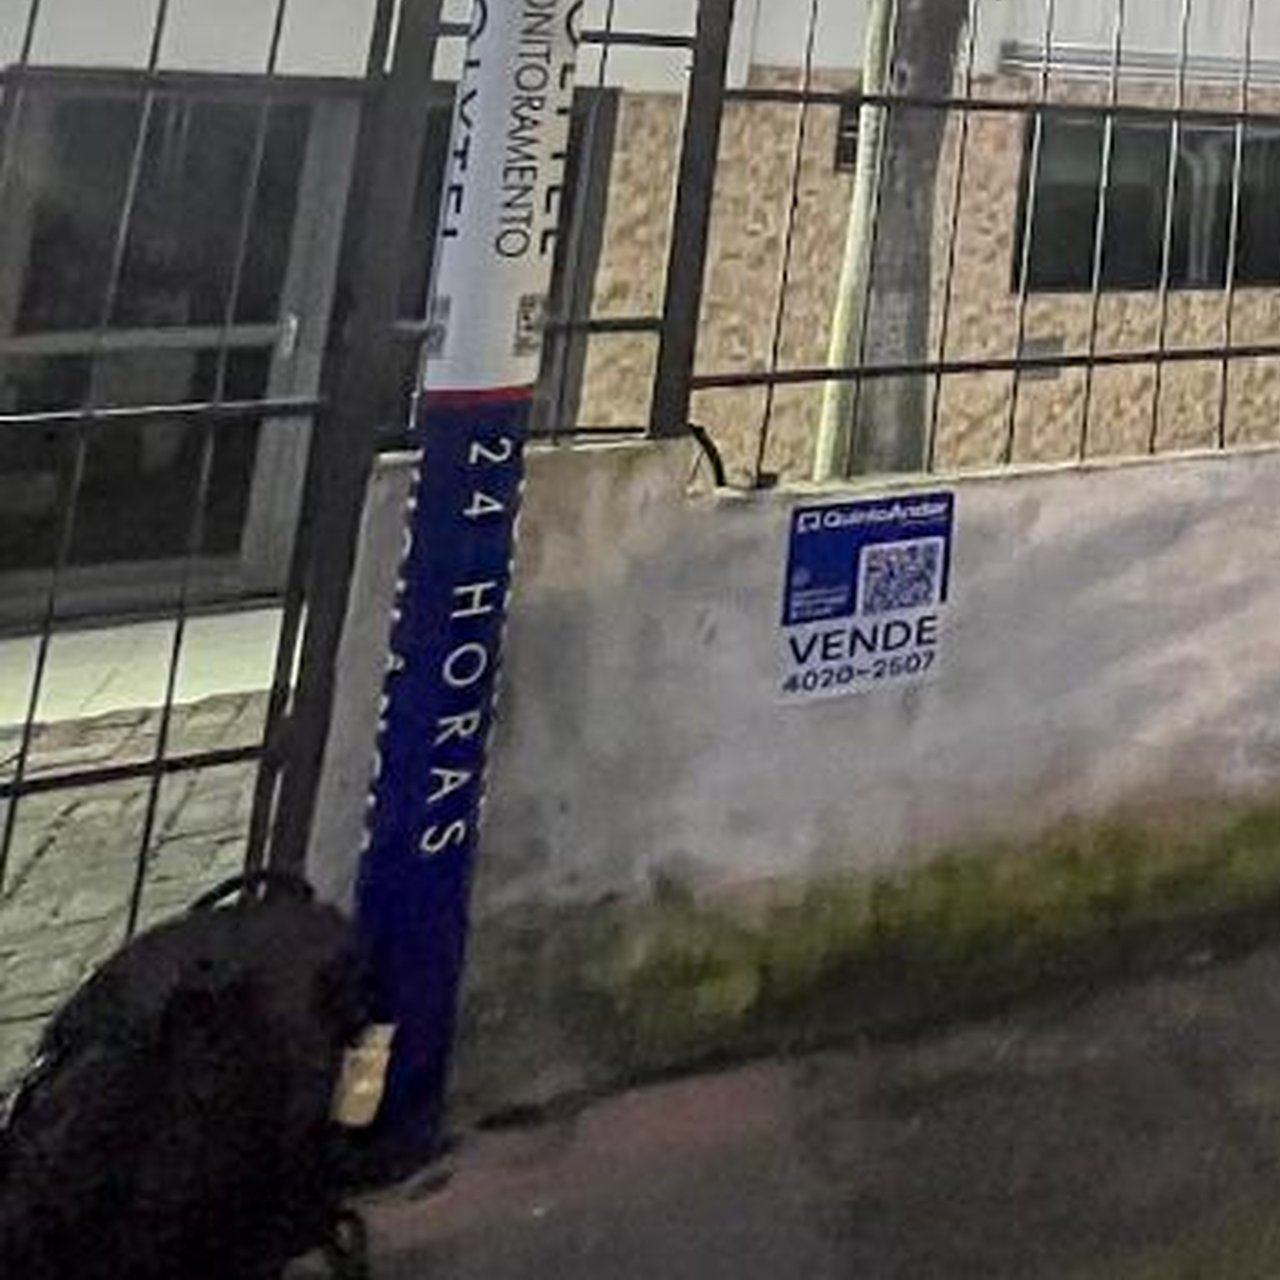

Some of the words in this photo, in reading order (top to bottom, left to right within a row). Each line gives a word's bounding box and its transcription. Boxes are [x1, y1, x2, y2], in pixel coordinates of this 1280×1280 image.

[463, 438, 511, 517] 24
[789, 616, 938, 665] VENDE
[420, 581, 497, 855] HORAS
